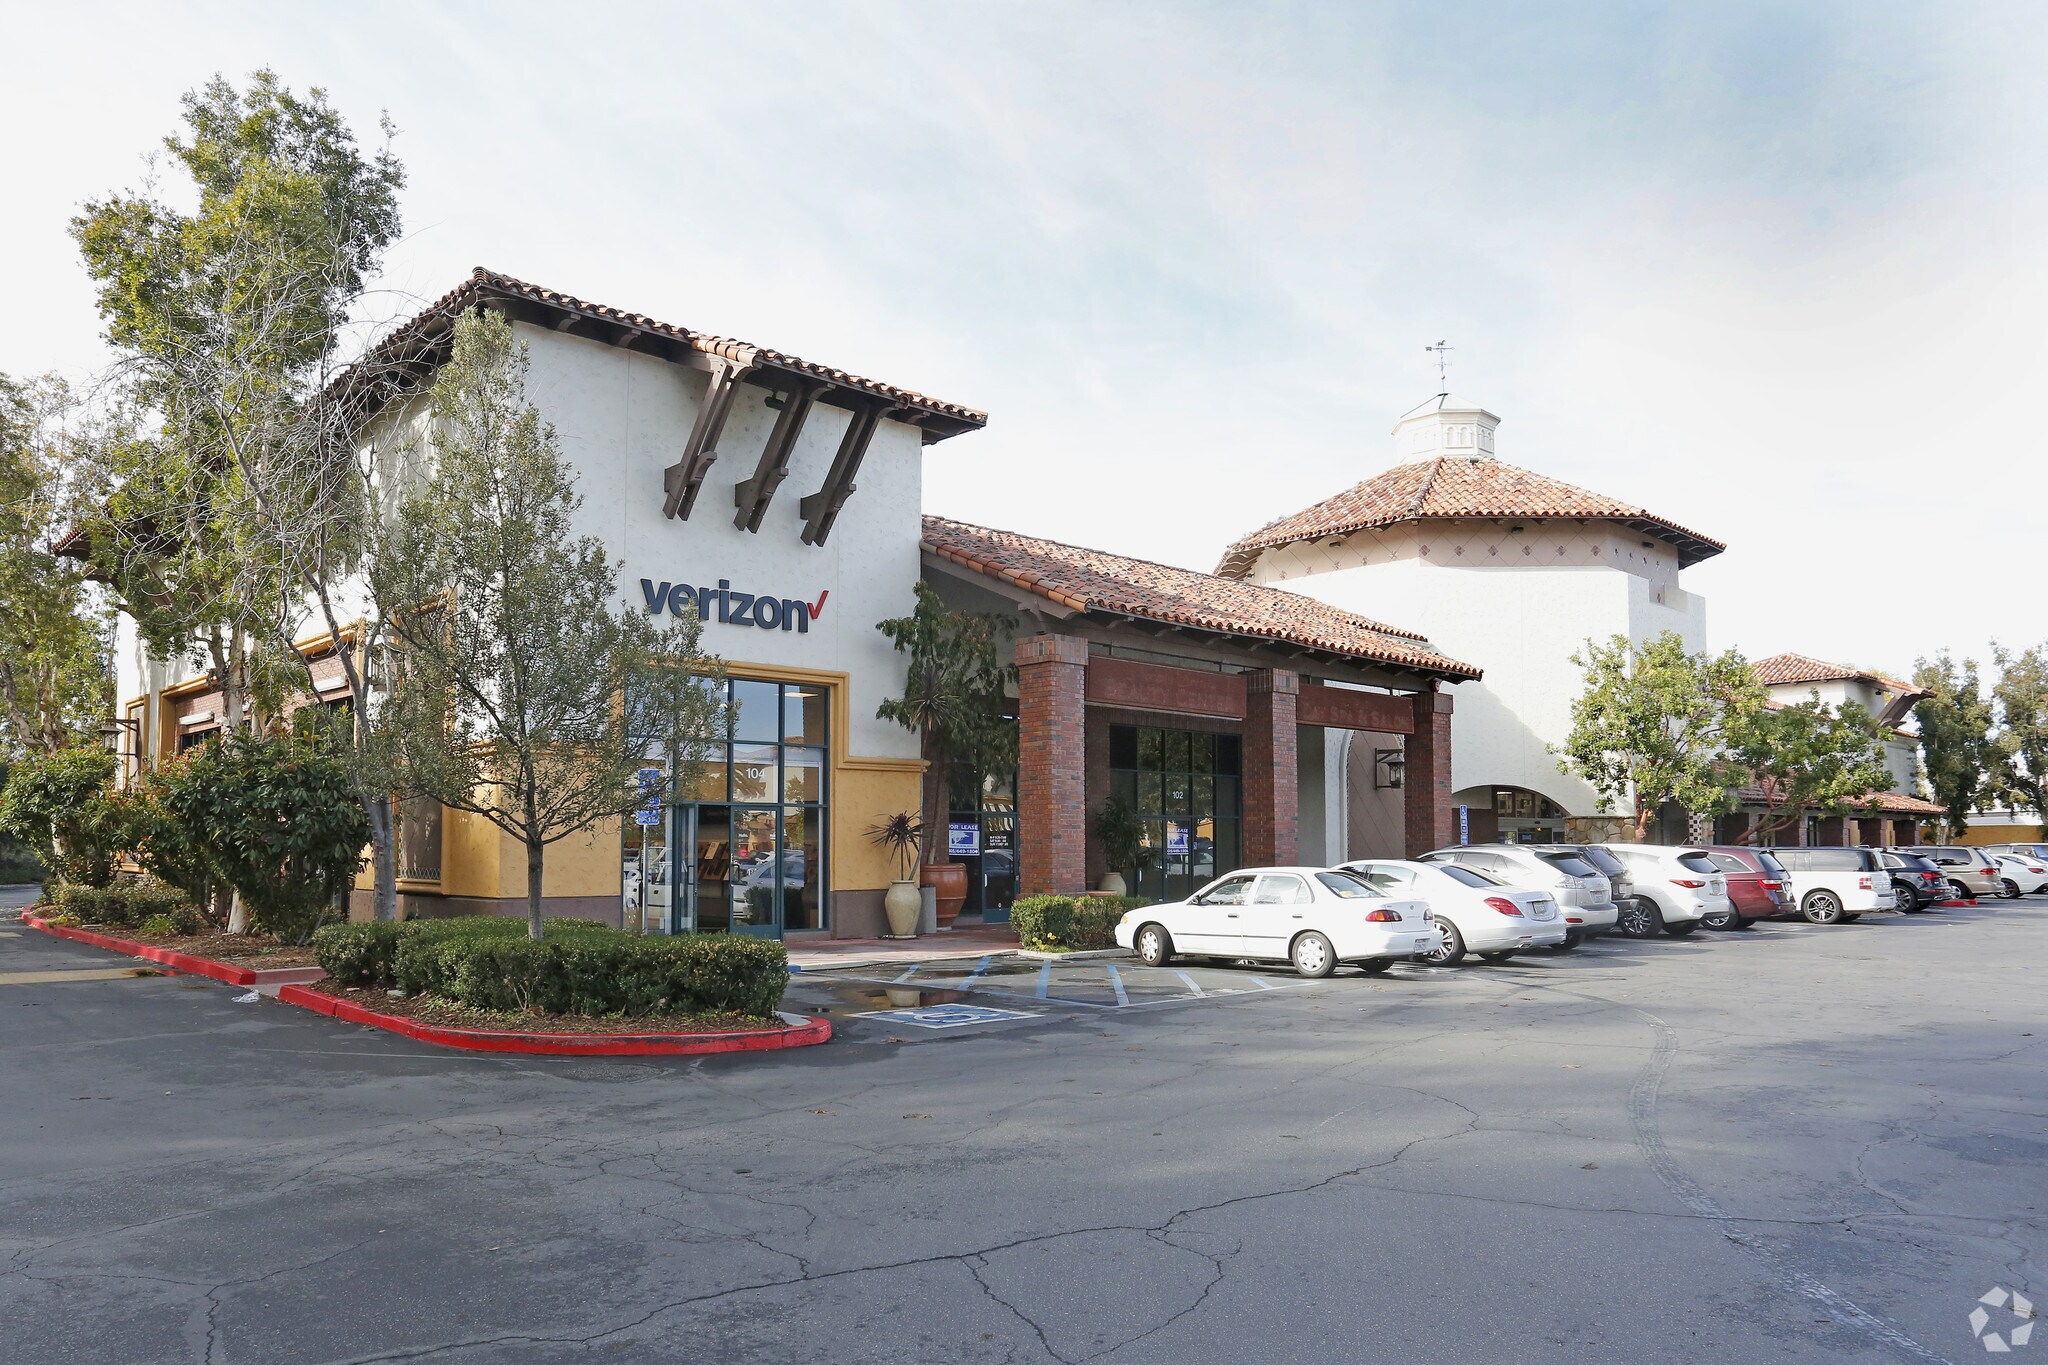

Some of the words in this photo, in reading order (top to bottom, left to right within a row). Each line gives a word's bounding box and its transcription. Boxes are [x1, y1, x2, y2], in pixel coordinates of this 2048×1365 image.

[640, 578, 809, 633] verizon
[746, 767, 765, 779] 104
[1173, 791, 1184, 799] 102
